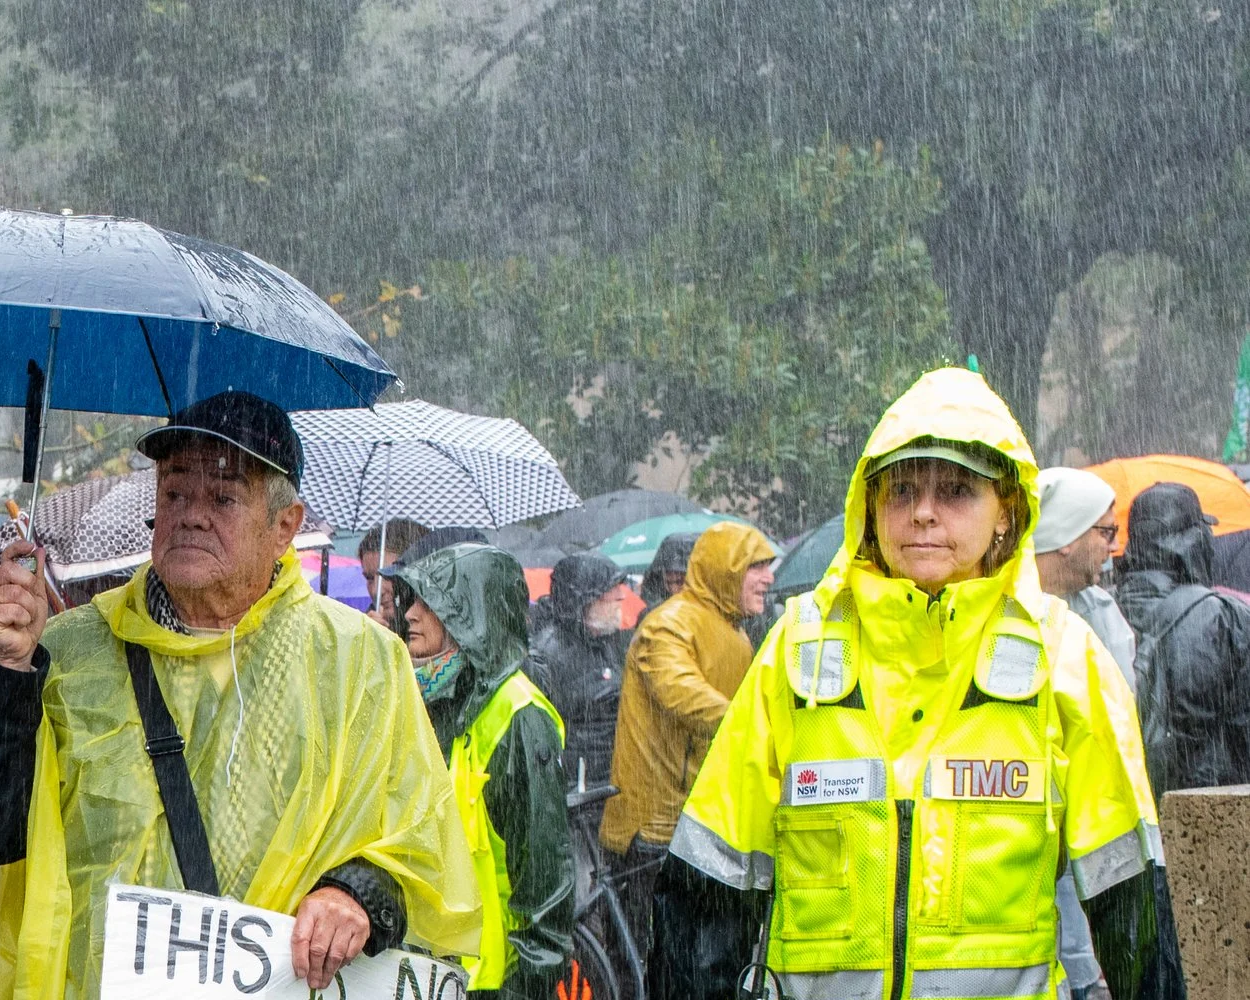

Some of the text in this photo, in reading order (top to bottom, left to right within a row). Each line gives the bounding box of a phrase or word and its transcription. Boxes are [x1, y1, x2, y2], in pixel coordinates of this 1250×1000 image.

[823, 776, 864, 787] Transport
[946, 760, 1029, 798] TMC
[797, 785, 817, 795] NSW
[823, 787, 859, 797] for NSW
[117, 892, 273, 994] THIS
